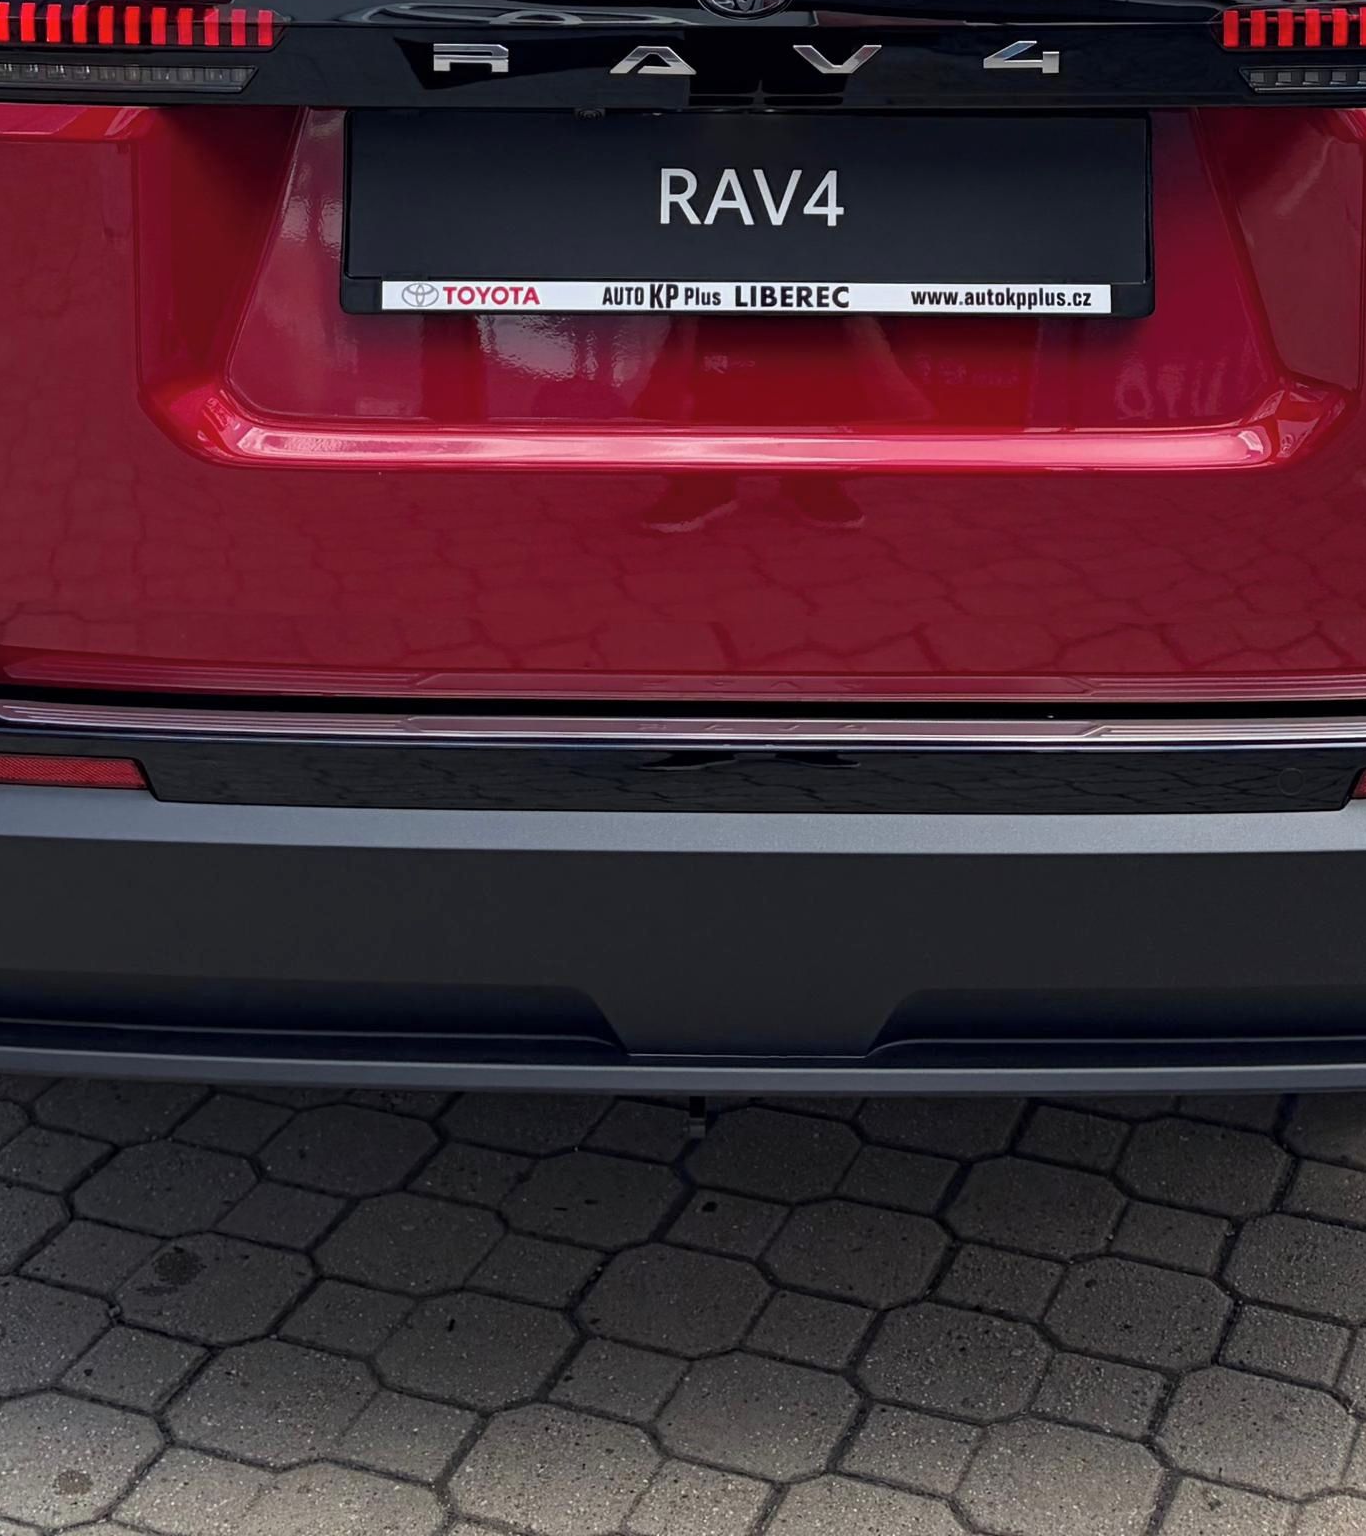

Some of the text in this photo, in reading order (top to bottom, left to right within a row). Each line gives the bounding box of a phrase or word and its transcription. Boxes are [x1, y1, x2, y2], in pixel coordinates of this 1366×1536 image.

[432, 40, 1061, 75] RAV4
[659, 166, 846, 227] RAV4
[442, 284, 1093, 311] TOYOTA AUTO KP Plus LIBEREC www.autokpplus.cz
